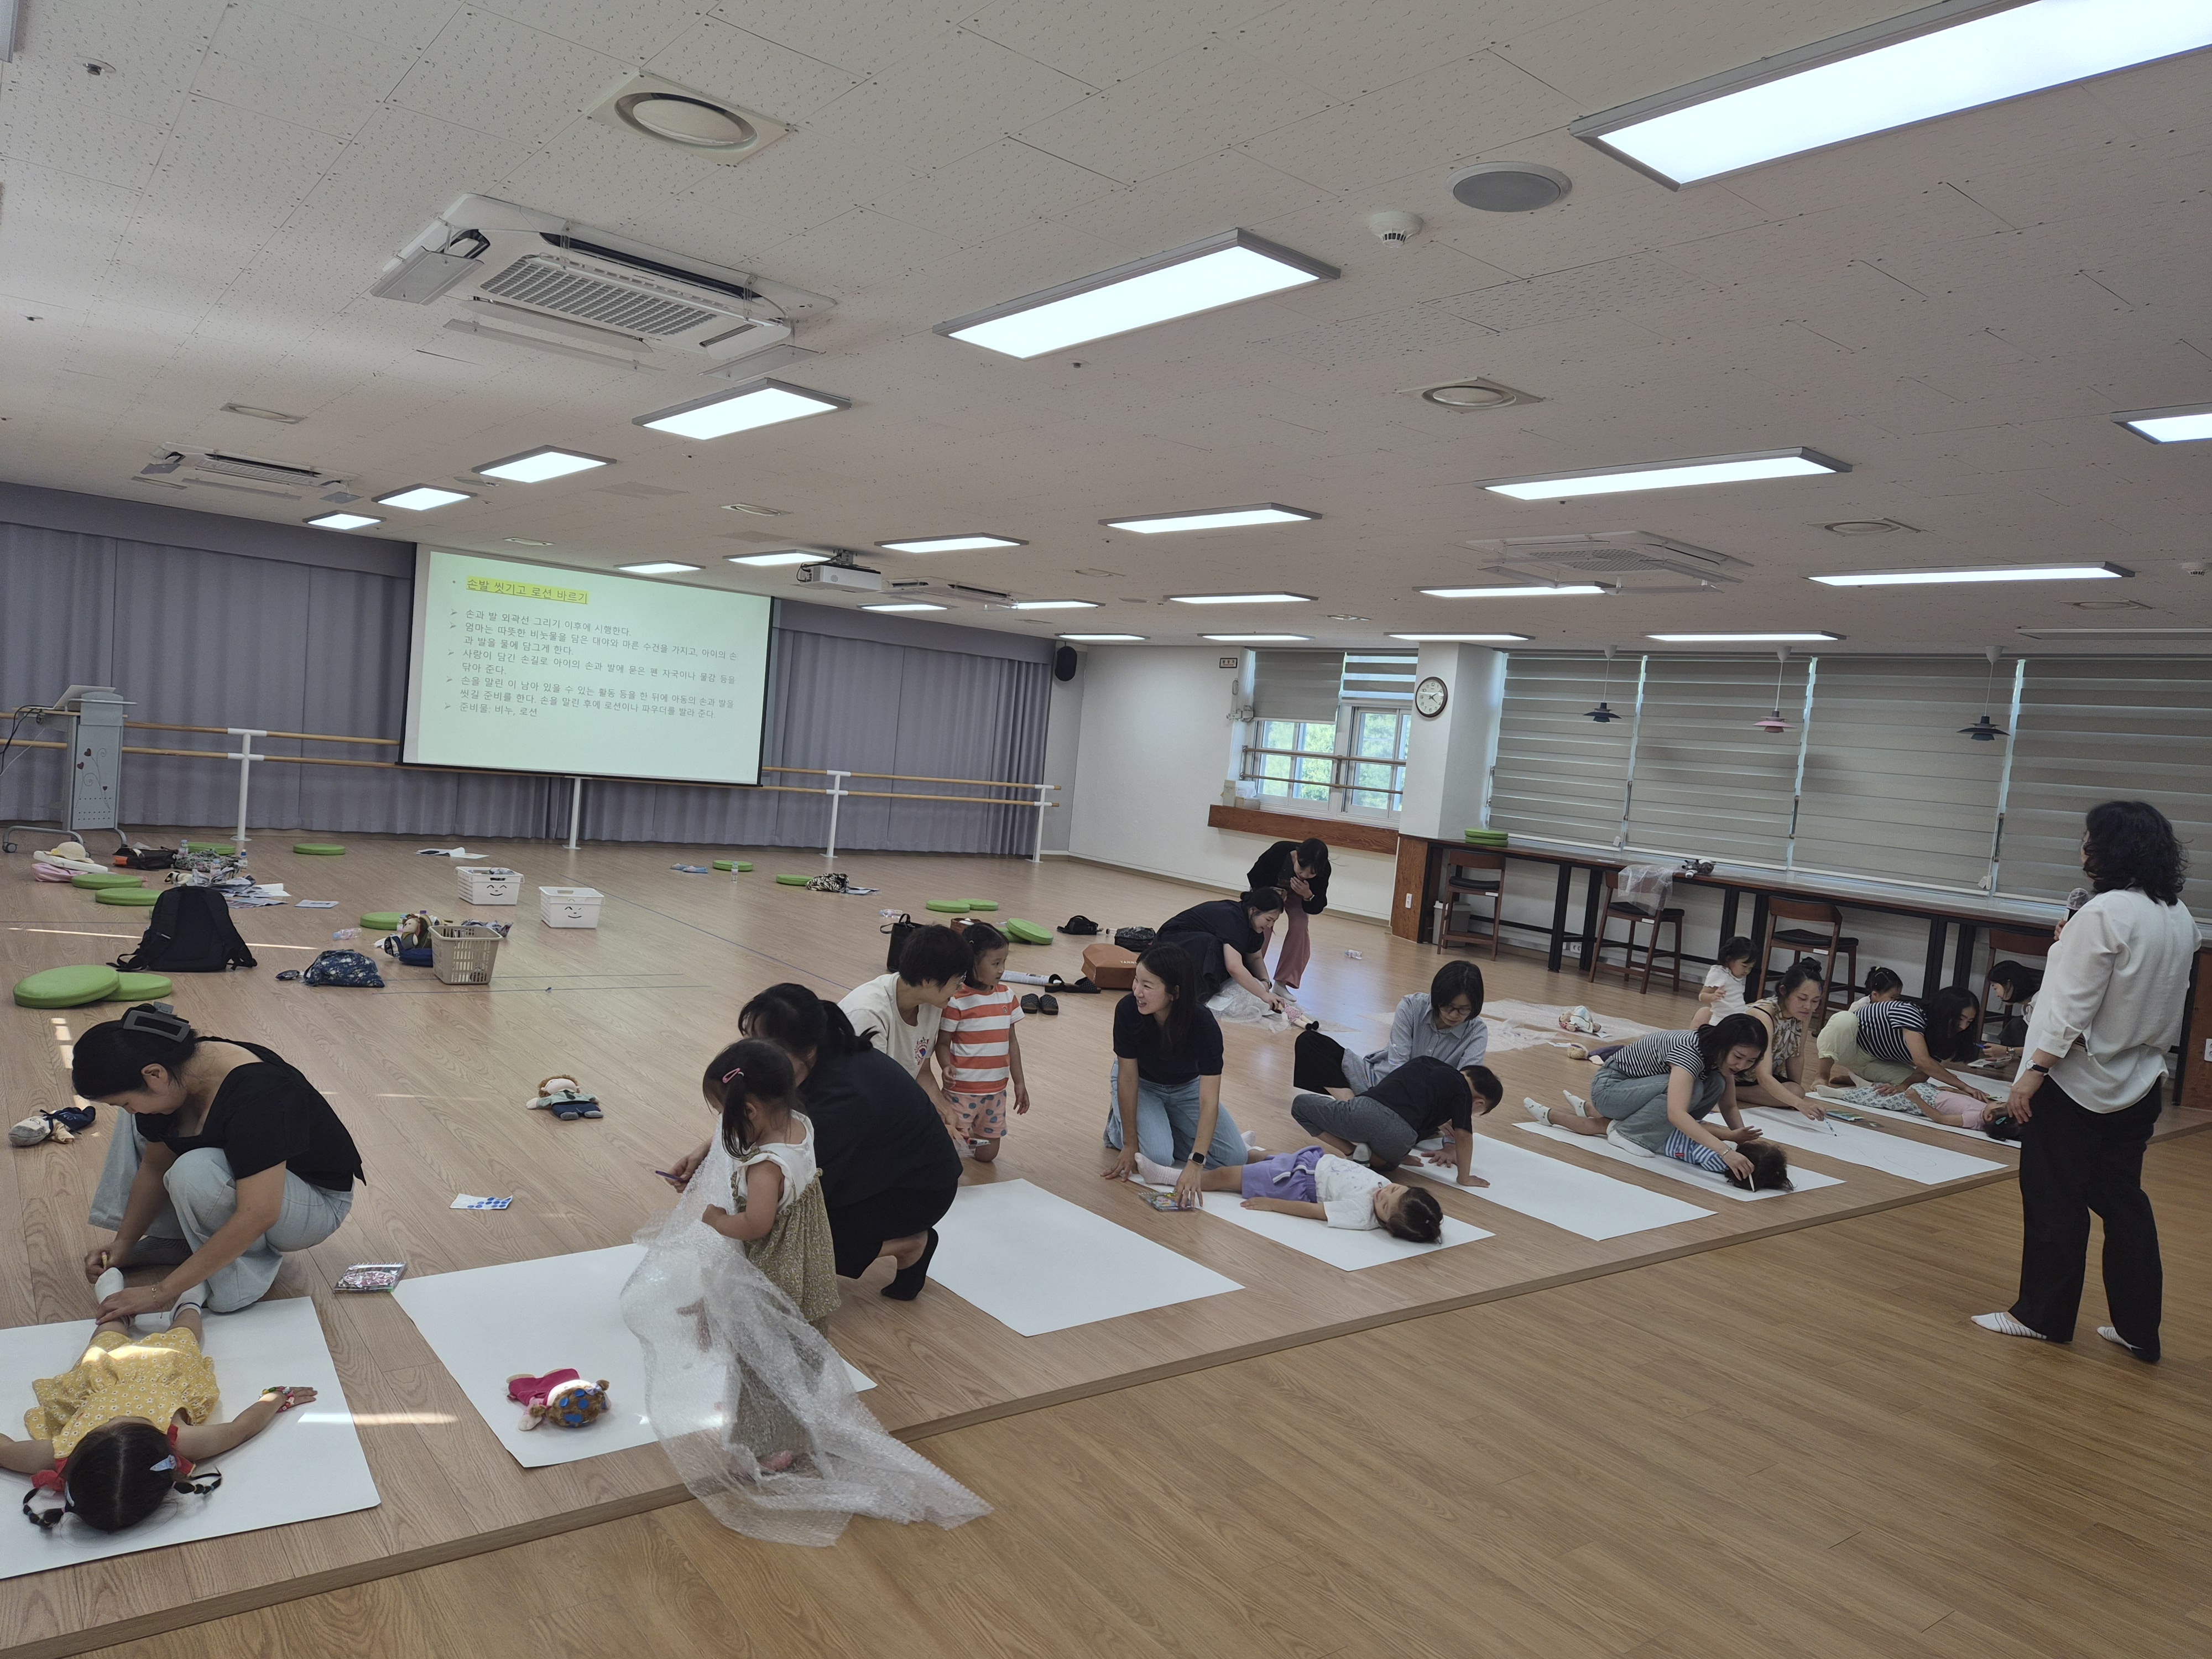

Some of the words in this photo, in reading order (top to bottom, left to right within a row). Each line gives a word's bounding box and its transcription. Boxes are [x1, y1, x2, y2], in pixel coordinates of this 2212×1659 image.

[467, 579, 489, 591] 손발
[494, 582, 526, 595] 씻기고
[531, 587, 551, 599] 로션
[557, 590, 588, 604] 바르기
[466, 609, 484, 619] 손과
[489, 612, 497, 621] 발
[502, 614, 529, 625] 외곽선
[533, 617, 560, 628] 그리기
[565, 620, 591, 632] 이후에
[594, 624, 631, 636] 시행한다.
[463, 636, 473, 645] 과
[478, 637, 496, 647] 발을
[500, 640, 518, 650] 물에
[523, 642, 550, 653] 담그게
[554, 645, 573, 655] 한다.
[466, 622, 493, 634] 엄마는
[498, 626, 526, 638] 따뜻한
[530, 630, 566, 642] 비눗물을
[571, 634, 588, 644] 담은
[593, 637, 619, 648] 대야와
[623, 640, 639, 650] 마른
[643, 643, 668, 653] 수건을
[672, 645, 698, 656] 가지고,
[702, 649, 726, 659] 아이의
[729, 652, 737, 660] 손
[462, 649, 492, 660] 사랑이
[498, 652, 515, 662] 담긴
[521, 655, 548, 665] 손길로
[554, 658, 580, 669] 아이의
[585, 661, 602, 671] 손과
[608, 664, 624, 674] 발에
[650, 667, 658, 676] 펜
[662, 670, 696, 680] 자국이나
[720, 675, 735, 685] 등을
[485, 665, 506, 675] 준다.
[460, 689, 479, 699] 씻길
[483, 691, 512, 702] 준비를
[516, 693, 536, 703] 한다.
[540, 696, 558, 706] 손을
[562, 697, 580, 707] 말린
[583, 700, 600, 709] 후에
[604, 701, 638, 712] 로션이나
[642, 705, 675, 716] 파우더를
[679, 707, 695, 717] 발라
[698, 709, 716, 718] 준다.
[461, 676, 480, 686] 손을
[485, 677, 503, 688] 말린
[508, 680, 516, 689] 이
[521, 681, 539, 691] 남아
[543, 683, 561, 693] 있을
[577, 686, 594, 696] 있는
[598, 688, 615, 698] 활동
[619, 690, 636, 700] 등을
[640, 692, 648, 701] 한
[651, 693, 667, 702] 뒤에
[671, 695, 696, 705] 아동의
[699, 697, 715, 707] 손과
[719, 699, 734, 709] 발을
[460, 702, 491, 713] 준비물:
[494, 705, 515, 716] 비누,
[519, 707, 537, 717] 로션
